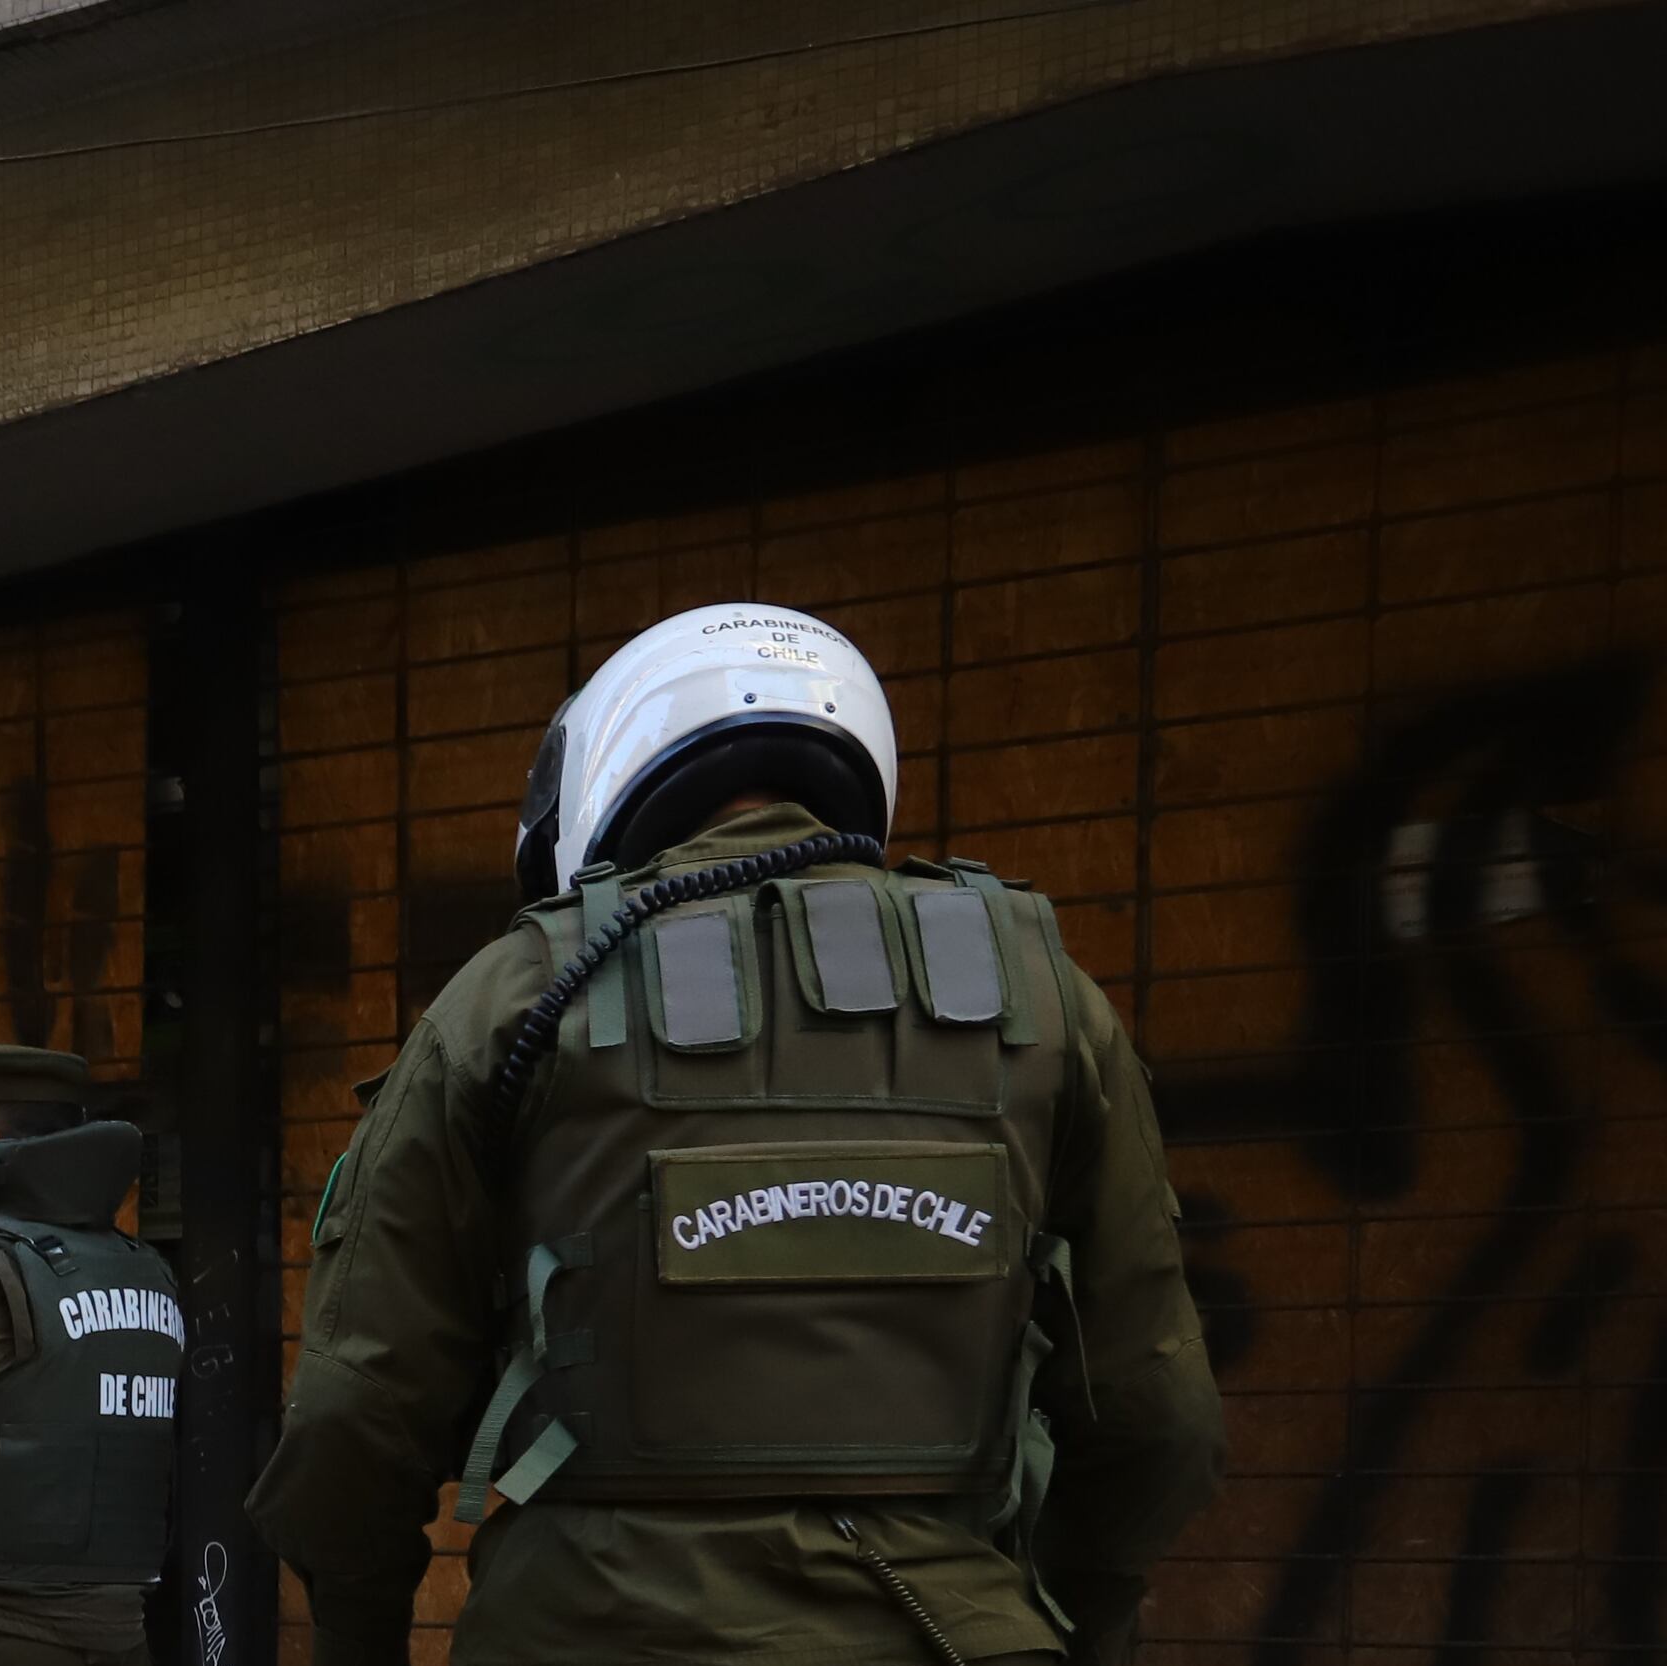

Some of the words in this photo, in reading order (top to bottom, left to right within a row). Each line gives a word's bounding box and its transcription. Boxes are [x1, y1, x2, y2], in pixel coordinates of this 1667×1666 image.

[702, 619, 849, 648] CARABINEROS
[772, 632, 800, 644] DE
[758, 647, 819, 663] CHILE
[672, 1180, 870, 1250] CARABINEROS
[871, 1184, 914, 1219] DE
[912, 1190, 992, 1247] CHILE
[99, 1373, 127, 1416] DE
